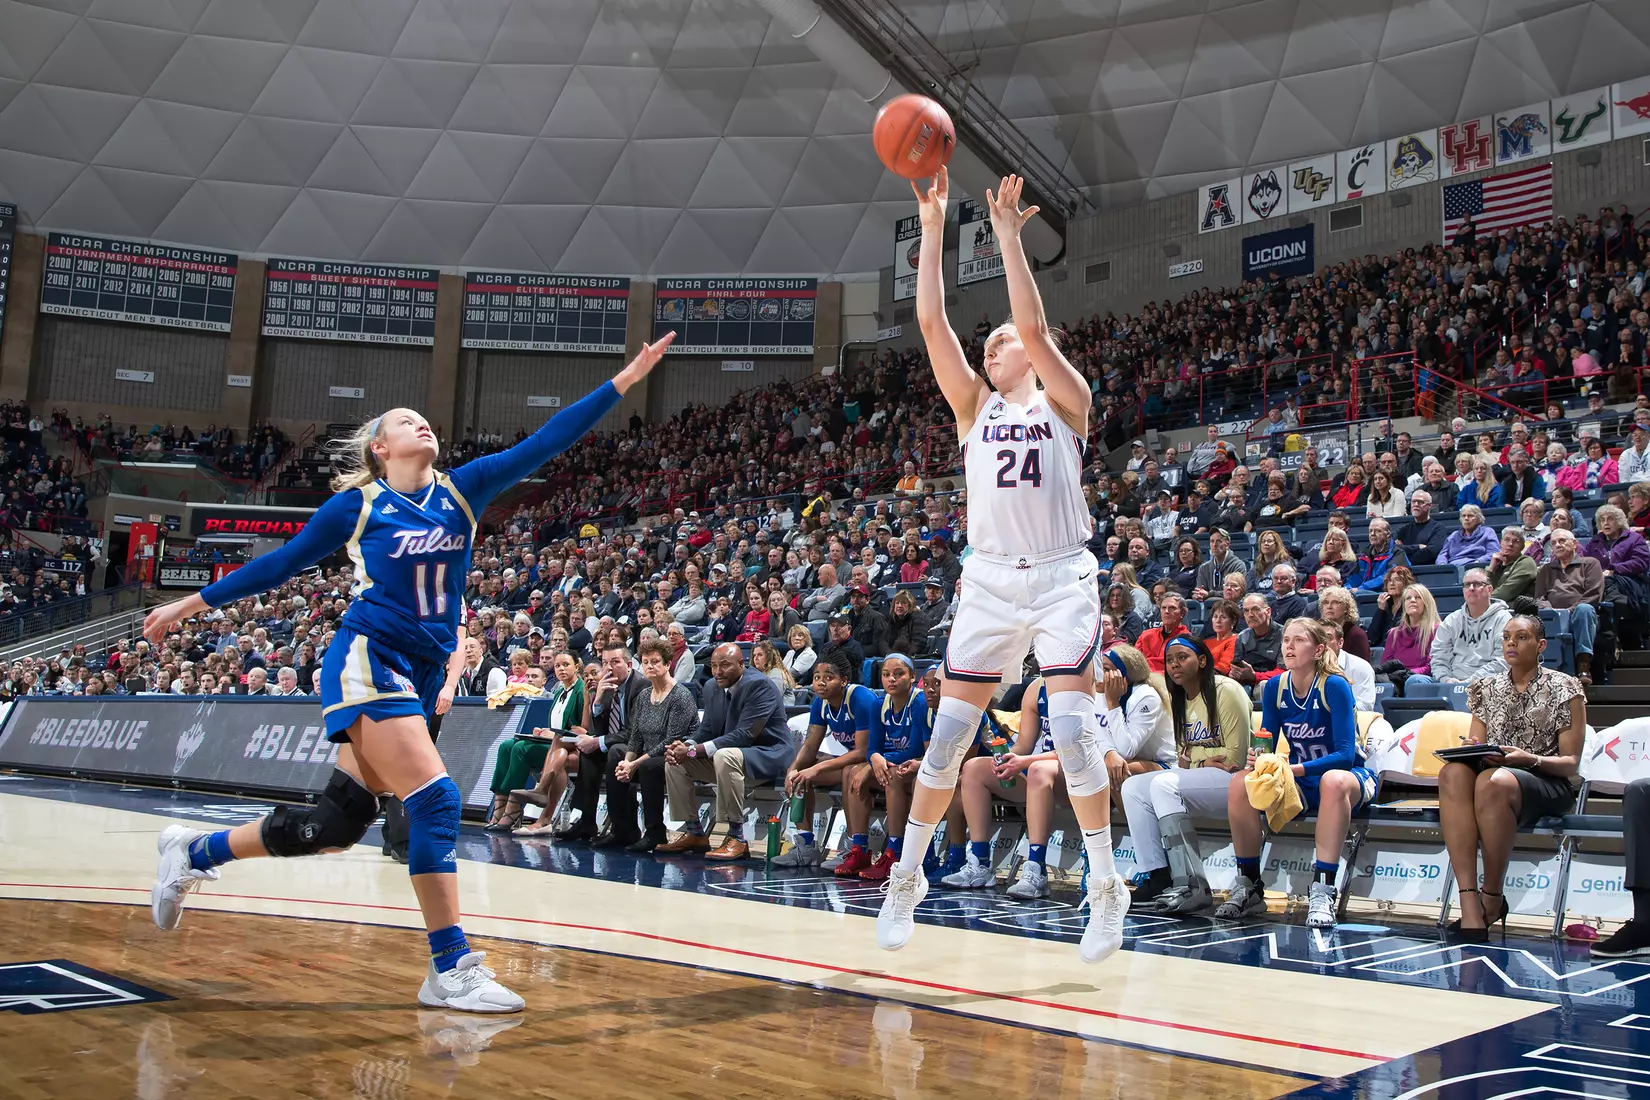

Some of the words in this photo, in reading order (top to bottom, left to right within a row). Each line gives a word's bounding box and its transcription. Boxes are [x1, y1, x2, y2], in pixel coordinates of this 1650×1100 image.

[1401, 143, 1416, 154] ECU
[1348, 158, 1369, 190] C
[1293, 167, 1333, 202] UCF
[901, 218, 913, 232] JIM
[898, 230, 916, 240] CLASS
[62, 236, 103, 252] NCAA
[111, 242, 228, 267] CHAMPIONSHIP
[1249, 240, 1307, 266] UCONN
[58, 246, 139, 266] TOURNAMENT
[144, 258, 228, 277] APPEARANCES
[963, 263, 974, 275] JIM
[1170, 267, 1182, 275] SEC
[1183, 261, 1202, 273] 220
[1249, 261, 1272, 272] UNIVERSITY
[1278, 255, 1307, 267] CONNECTICUT
[50, 256, 71, 270] 2000
[77, 259, 98, 273] 2002
[105, 262, 126, 276] 2003
[132, 265, 153, 279] 2004
[159, 268, 180, 283] 2005
[185, 272, 206, 286] 2006
[212, 275, 232, 289] 2008
[278, 261, 316, 272] NCAA
[323, 264, 430, 282] CHAMPIONSHIP
[959, 270, 987, 283] FOUNDING
[47, 273, 69, 287] 2009
[75, 276, 96, 290] 2011
[104, 279, 123, 293] 2012
[130, 283, 151, 296] 2014
[157, 286, 177, 299] 2016
[310, 274, 347, 284] SWEET
[352, 277, 397, 287] SIXTEEN
[477, 274, 512, 285] NCAA
[519, 275, 621, 289] CHAMPIONSHIP
[667, 280, 701, 289] NCAA
[708, 280, 808, 290] CHAMPIONSHIP
[270, 280, 288, 293] 1956
[294, 283, 314, 295] 1964
[319, 285, 337, 297] 1976
[344, 286, 362, 299] 1990
[369, 288, 386, 300] 1991
[392, 289, 411, 302] 1994
[417, 290, 435, 304] 1995
[516, 286, 544, 294] ELITE
[550, 287, 579, 296] EIGHT
[707, 290, 735, 298] FINAL
[269, 298, 287, 310] 1996
[292, 300, 311, 312] 1998
[318, 301, 336, 313] 1999
[342, 302, 361, 315] 2002
[366, 304, 386, 317] 2003
[390, 306, 410, 319] 2004
[414, 307, 434, 321] 2006
[468, 294, 485, 306] 1964
[492, 295, 509, 307] 1990
[515, 296, 532, 307] 1995
[539, 297, 556, 309] 1998
[562, 297, 579, 309] 1999
[584, 298, 603, 310] 2002
[607, 299, 626, 311] 2004
[47, 305, 119, 319] CONNECTICUT
[124, 314, 155, 324] MEN'S
[160, 317, 225, 331] BASKETBALL
[265, 313, 285, 327] 2009
[291, 315, 310, 328] 2011
[315, 317, 334, 330] 2014
[466, 310, 485, 321] 2006
[490, 310, 508, 322] 2009
[513, 311, 531, 323] 2011
[536, 312, 554, 324] 2014
[267, 328, 333, 339] CONNECTICUT
[337, 332, 366, 341] MEN'S
[370, 334, 429, 346] BASKETBALL
[888, 327, 901, 337] 218
[466, 339, 528, 349] CONNECTICUT
[533, 342, 559, 351] MEN'S
[563, 343, 620, 353] BASKETBALL
[753, 346, 809, 354] BASKETBALL
[740, 361, 751, 370] 10
[144, 373, 152, 381] 7
[354, 389, 362, 398] 8
[550, 397, 557, 406] 9
[982, 421, 1053, 444] UCONN
[1280, 456, 1302, 466] SEC
[1318, 447, 1345, 468] 22
[996, 448, 1042, 489] 24
[234, 521, 307, 535] RICHAR
[388, 526, 466, 559] Tulsa
[61, 560, 82, 573] 117
[160, 568, 211, 581] BEAR'S
[414, 562, 449, 618] 11
[29, 717, 149, 750] #BLEEDBLUE
[1282, 722, 1326, 740] Tulsa
[1363, 862, 1441, 880] genius3D
